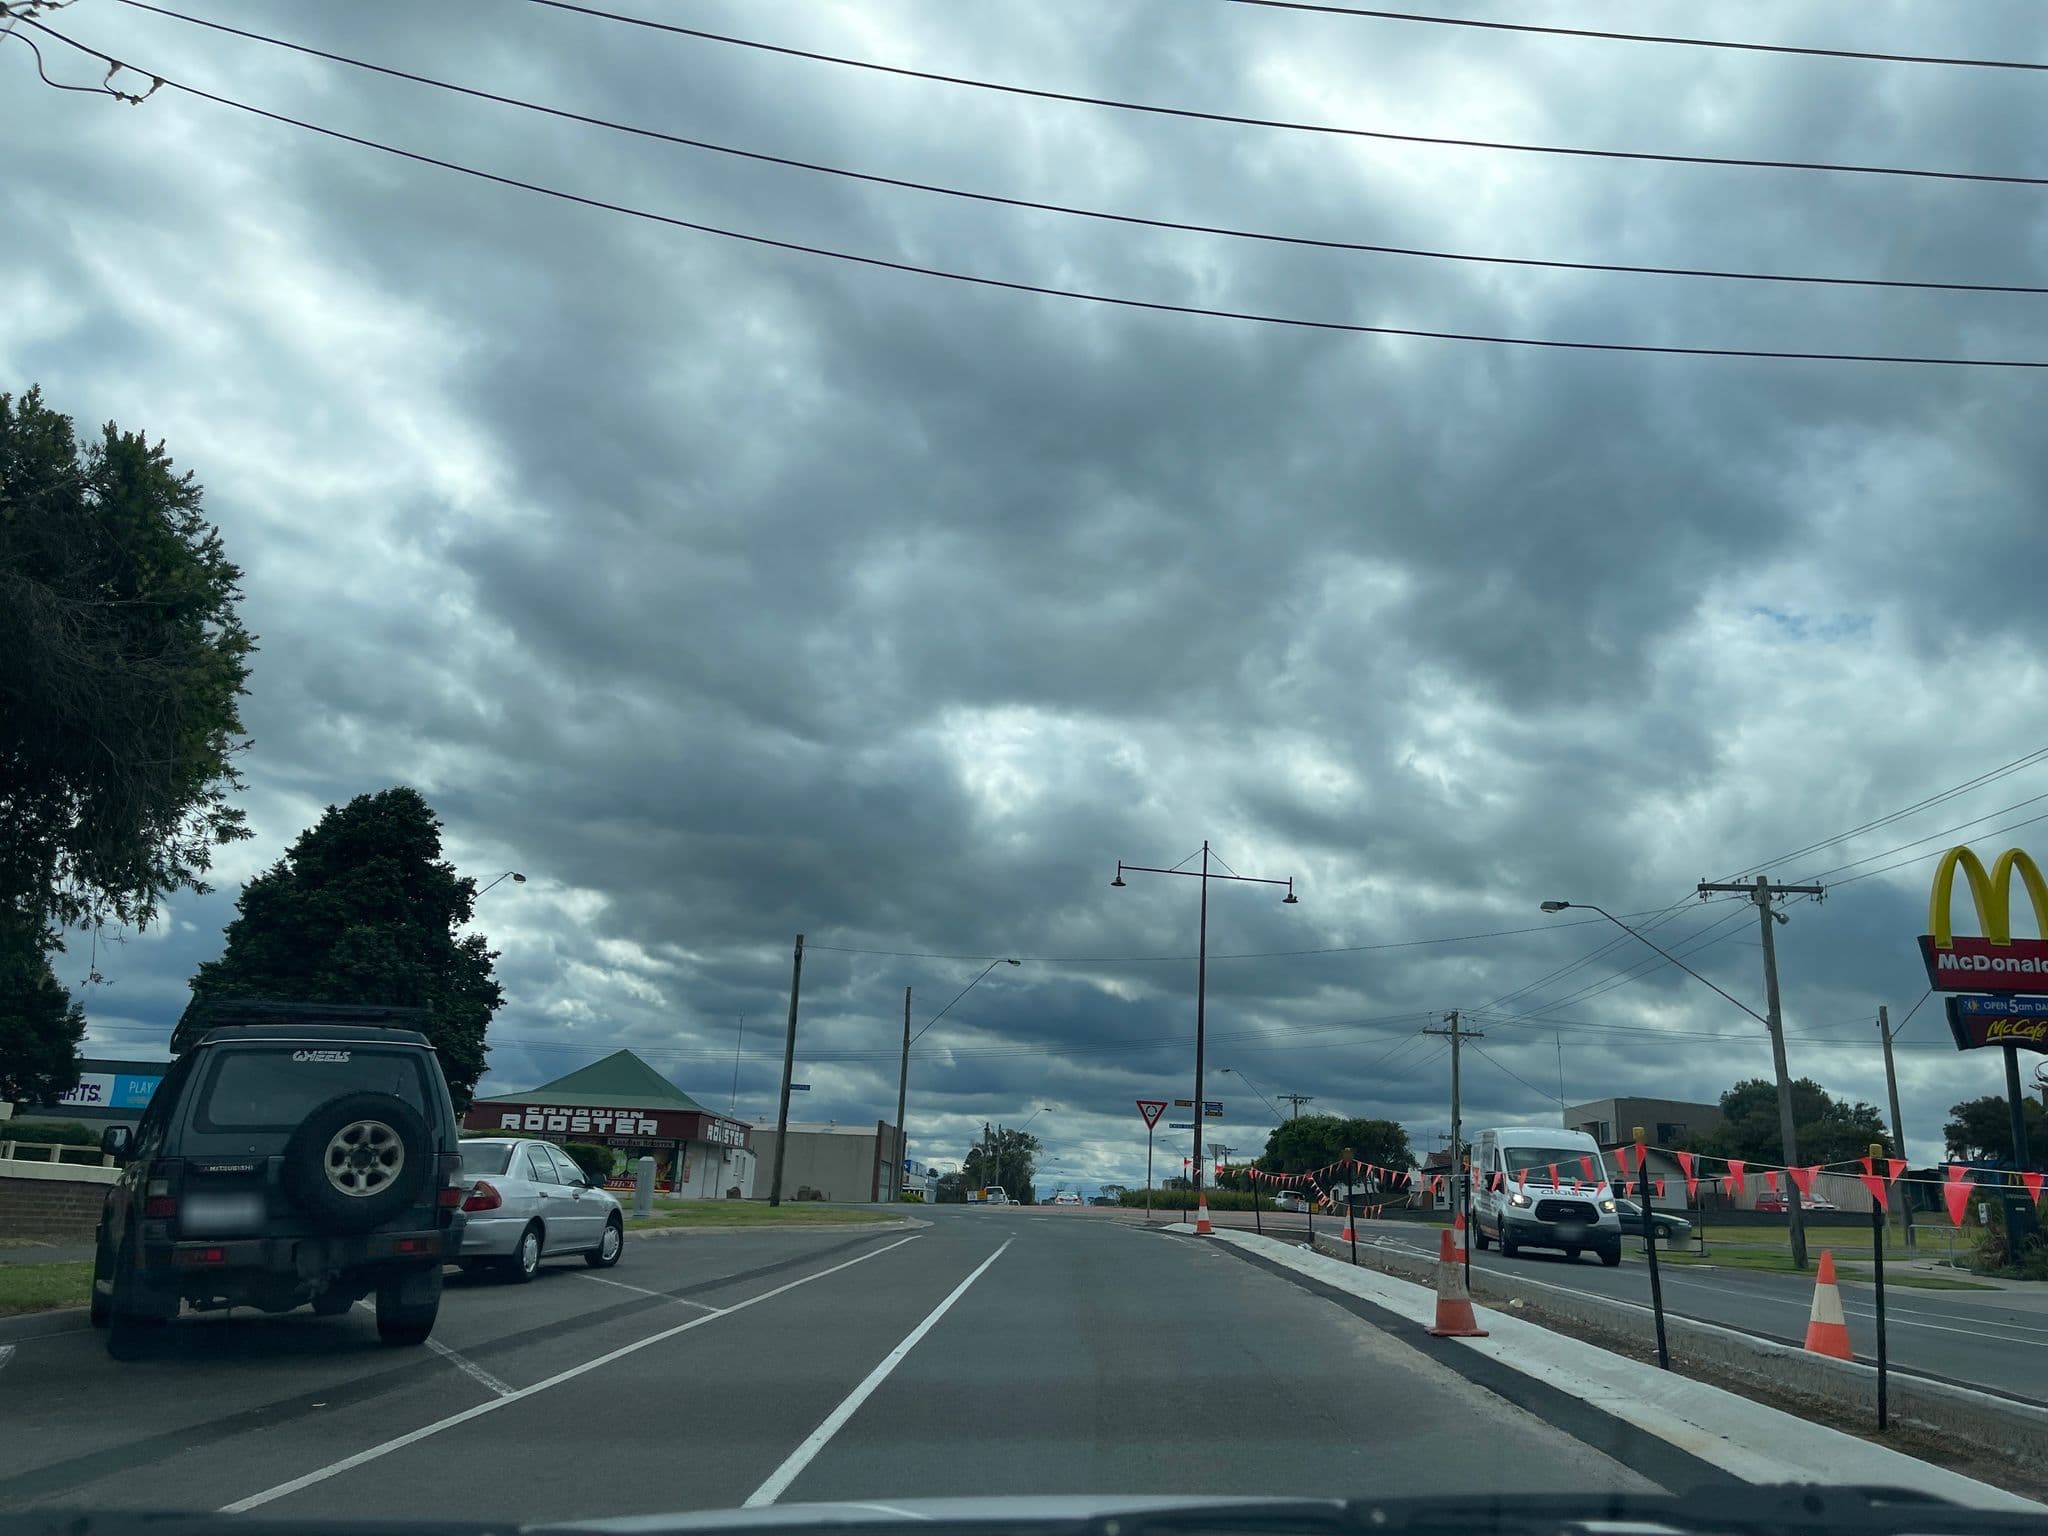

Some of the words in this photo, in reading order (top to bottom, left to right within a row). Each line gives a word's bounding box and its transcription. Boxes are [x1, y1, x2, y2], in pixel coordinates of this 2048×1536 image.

[1983, 1001, 2008, 1010] OPEN
[2009, 999, 2033, 1014] 5am
[128, 1080, 154, 1094] PLAY
[525, 1107, 645, 1119] CANADIAN
[500, 1113, 658, 1136] ROOSTER
